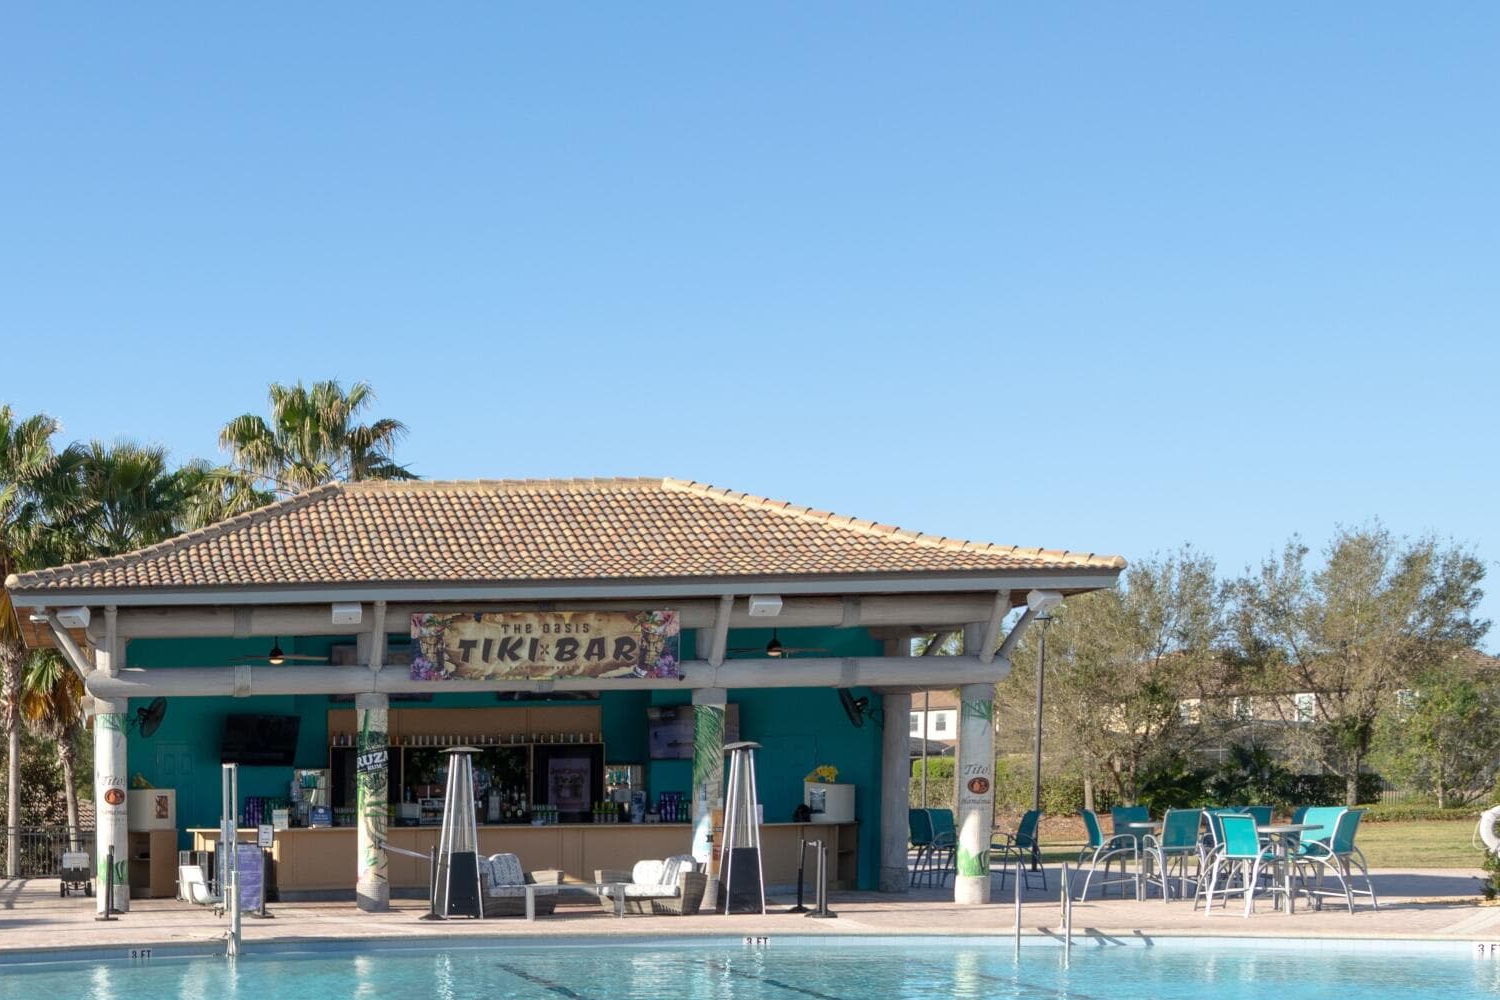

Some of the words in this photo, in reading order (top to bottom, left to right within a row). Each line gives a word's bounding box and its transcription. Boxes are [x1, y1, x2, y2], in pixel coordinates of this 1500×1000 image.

[458, 636, 541, 664] TIKI
[554, 636, 638, 663] BAR
[756, 936, 768, 945] FT
[140, 949, 151, 959] FT
